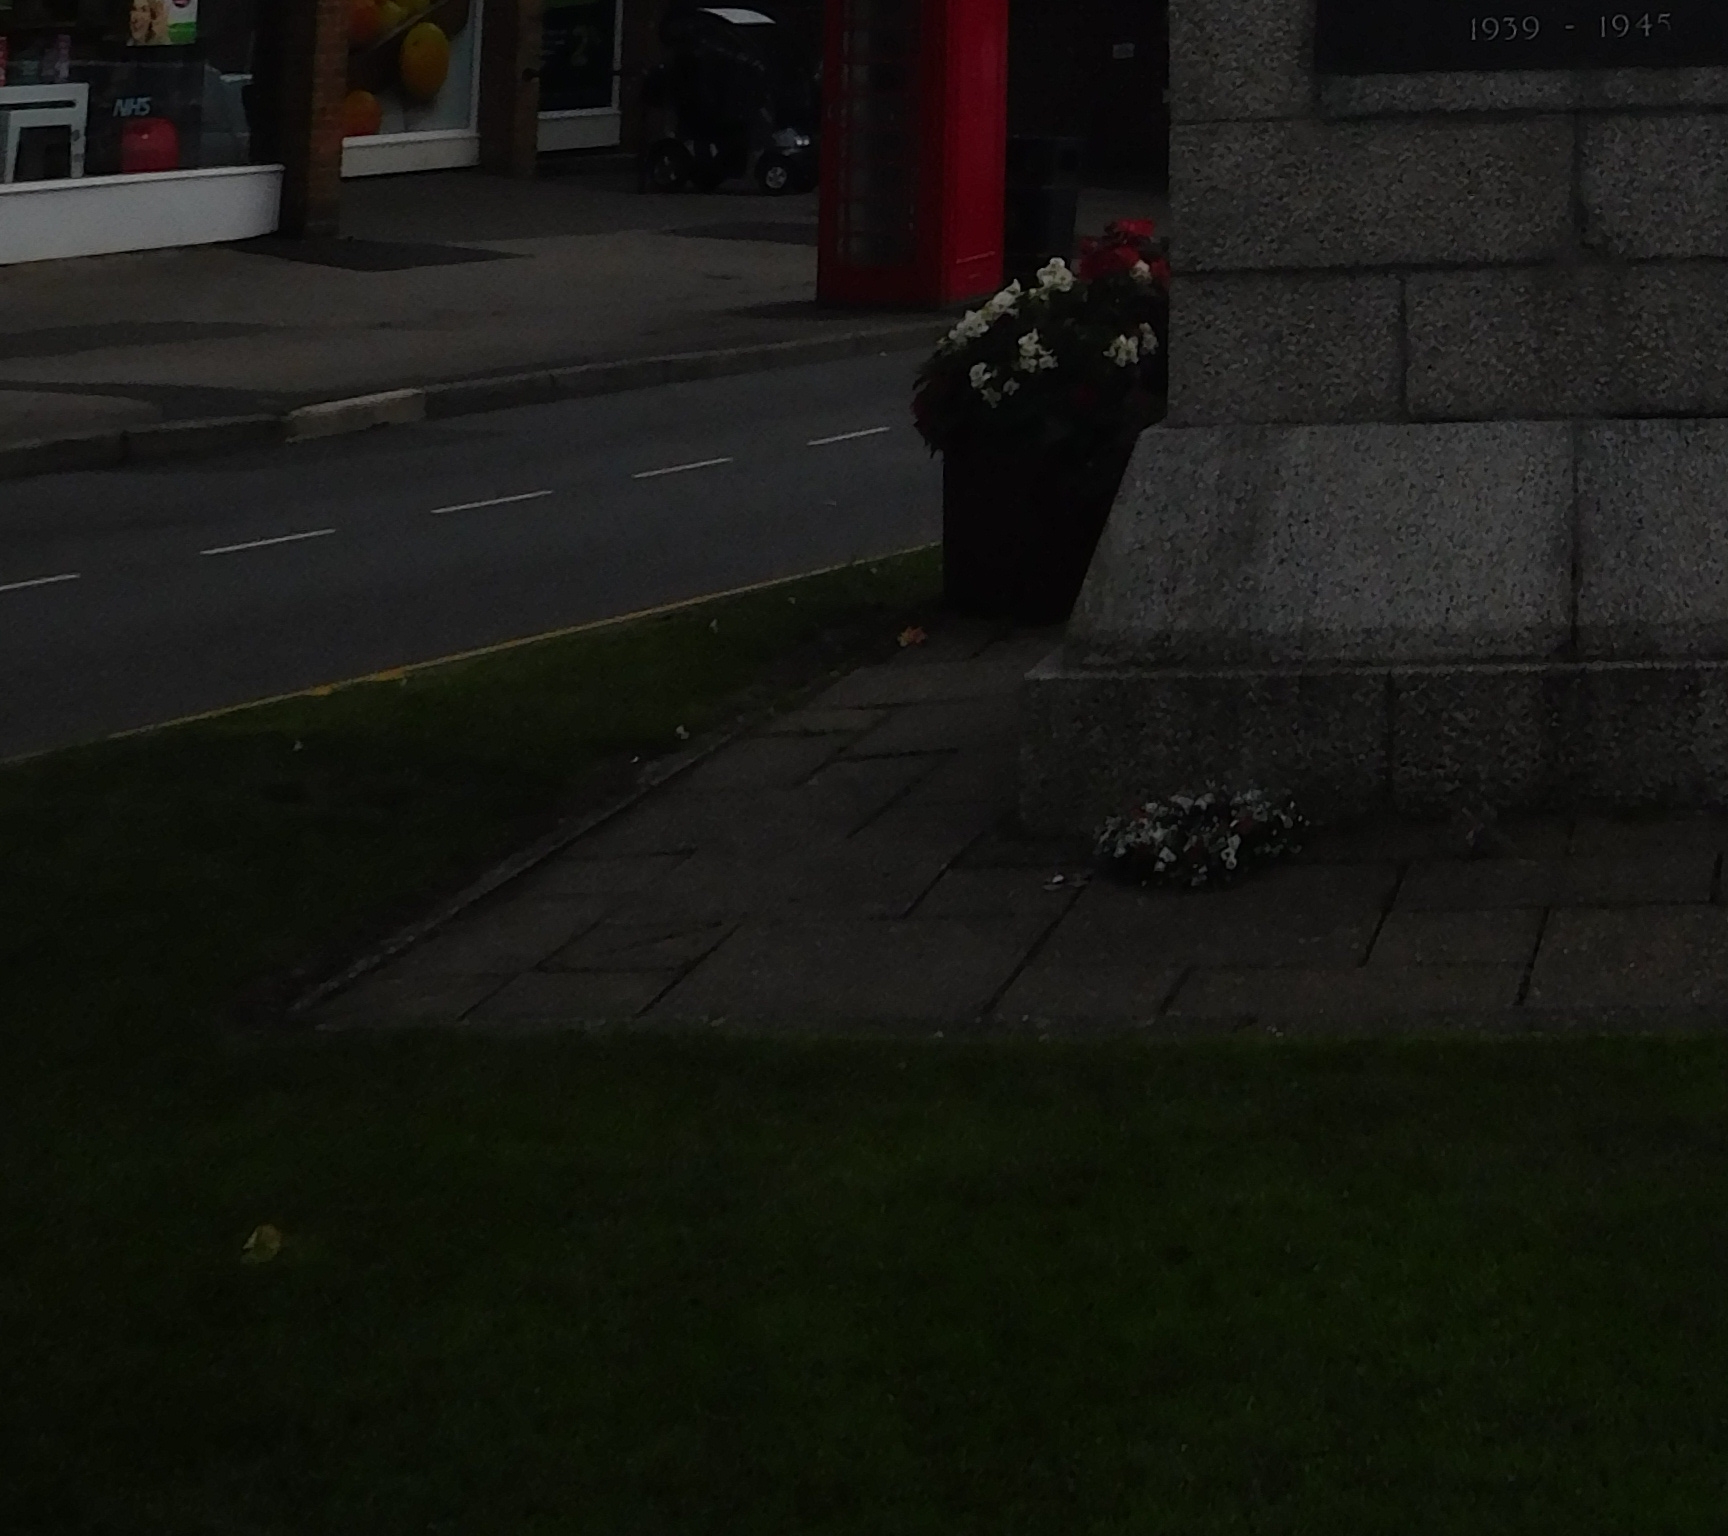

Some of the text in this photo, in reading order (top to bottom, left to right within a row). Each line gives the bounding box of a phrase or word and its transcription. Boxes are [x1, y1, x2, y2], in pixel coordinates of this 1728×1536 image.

[1471, 16, 1540, 41] 1939
[1601, 13, 1671, 38] 1945
[112, 96, 151, 117] NHS
